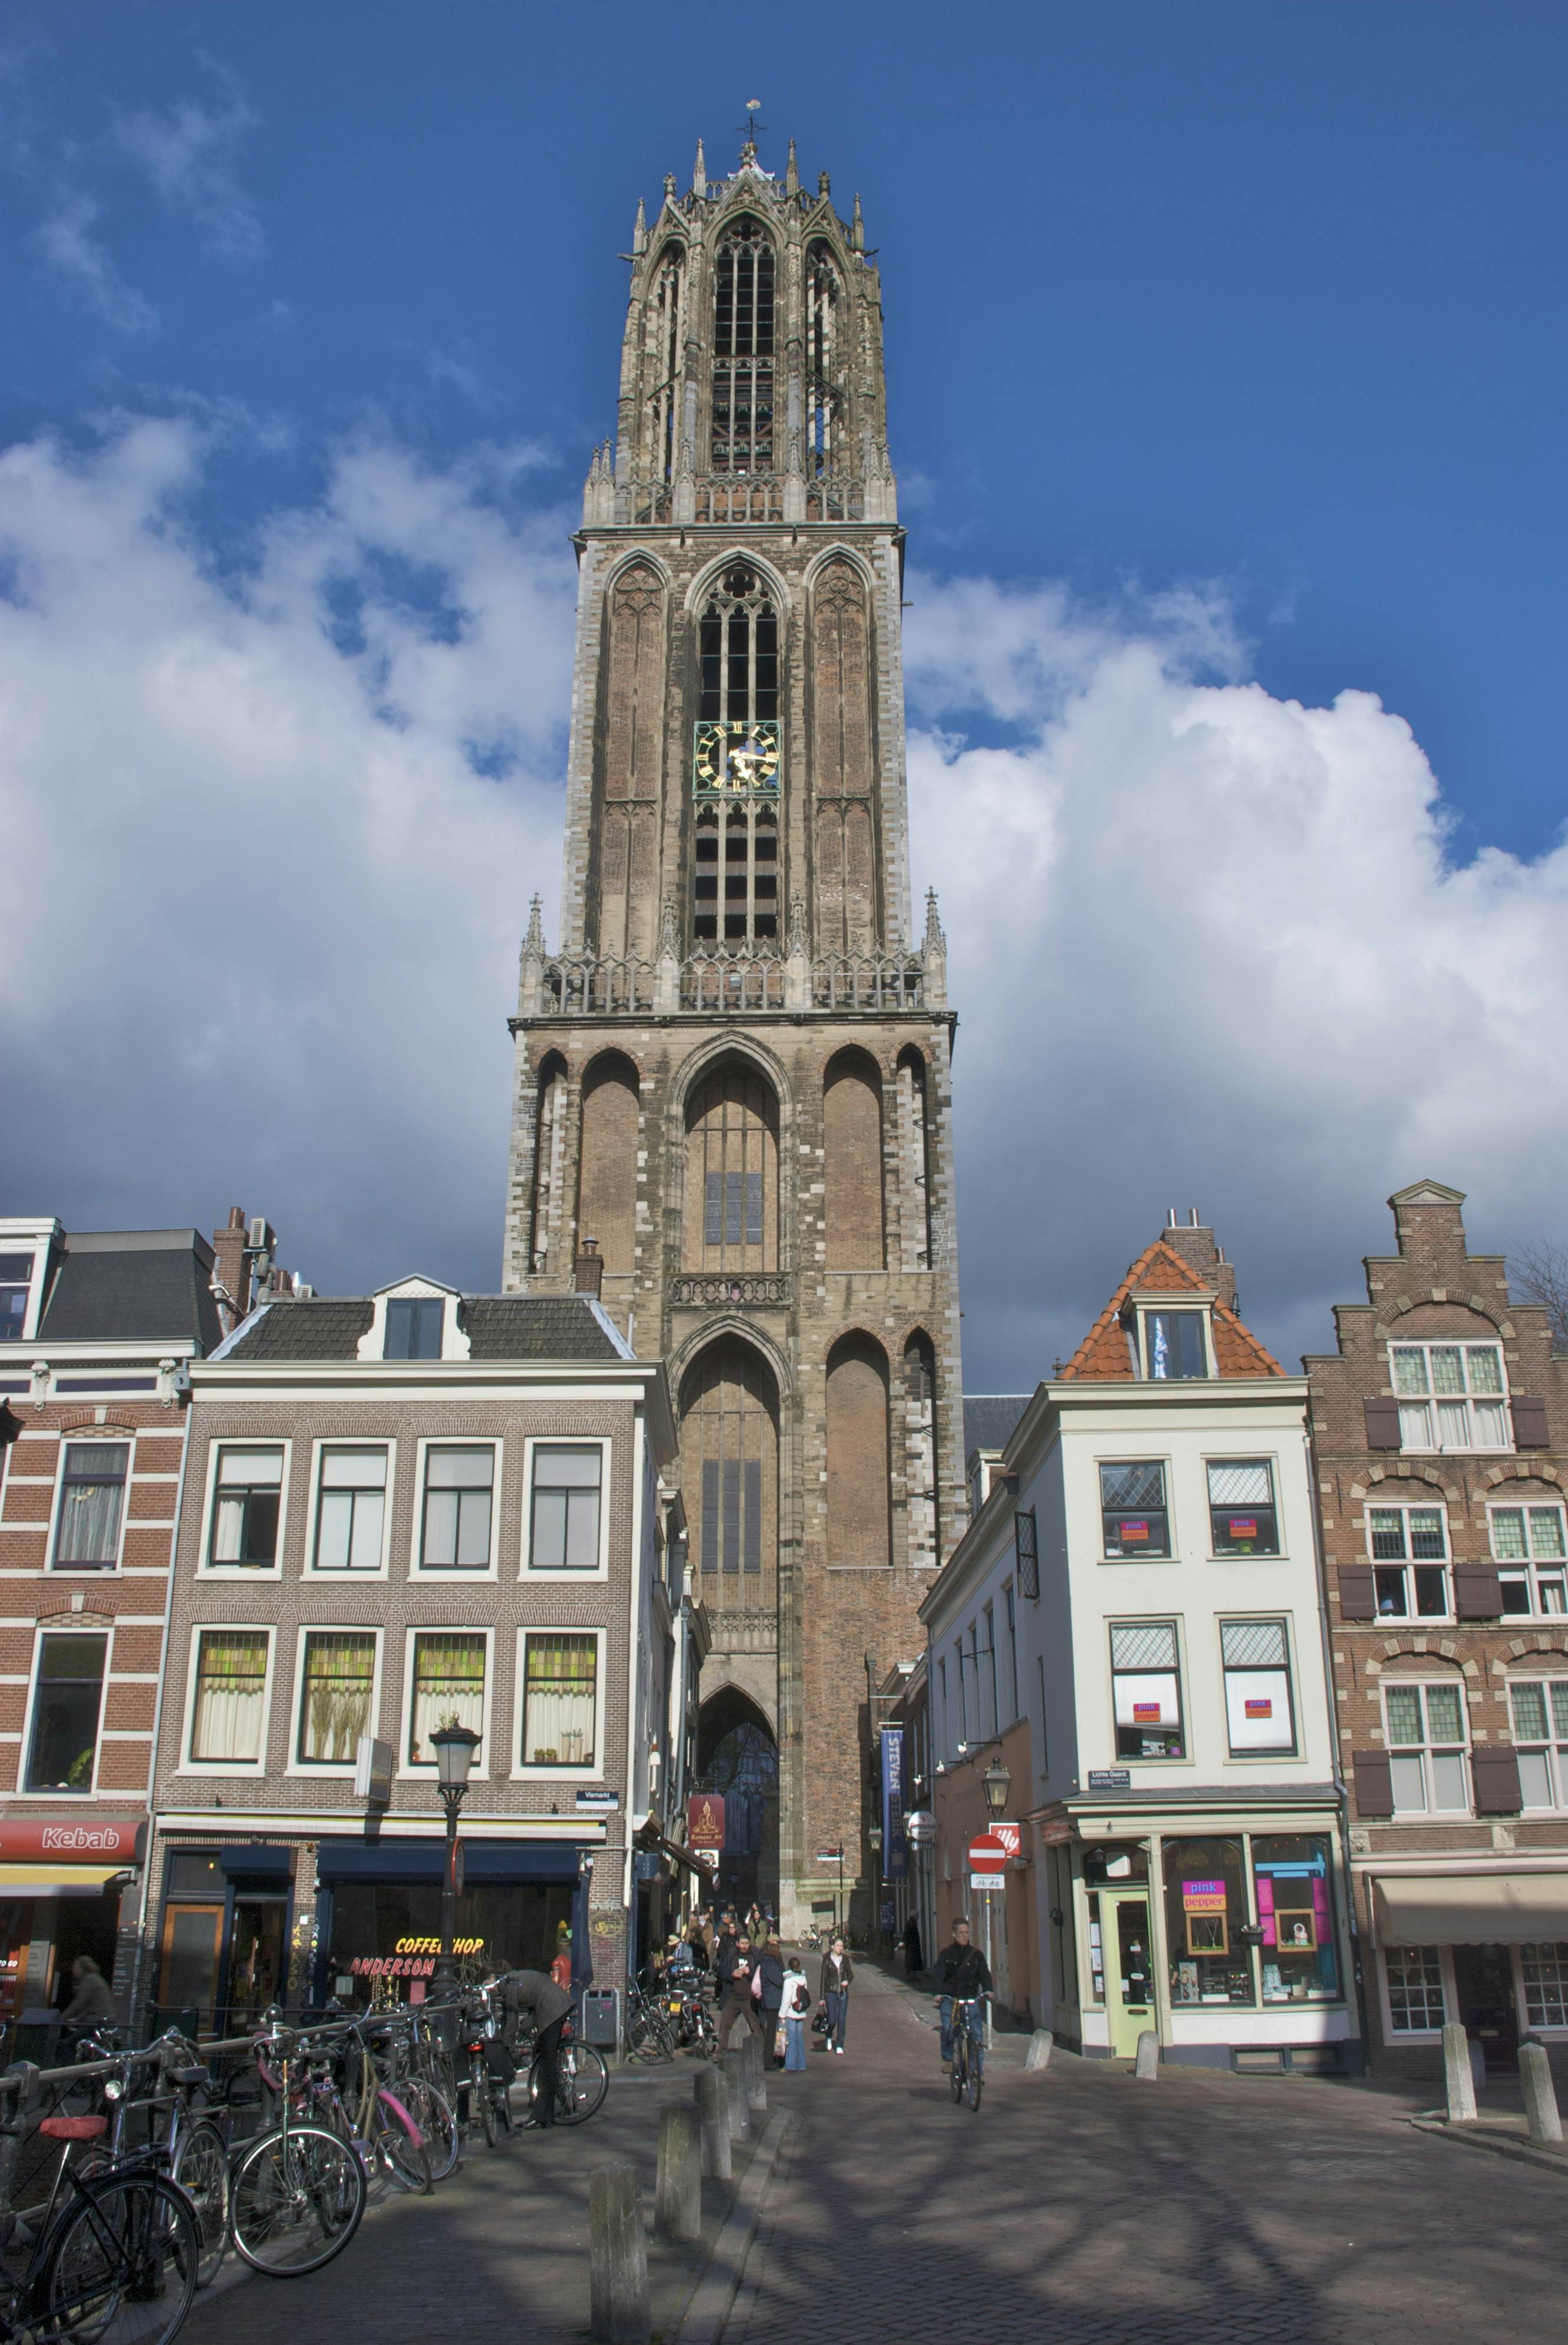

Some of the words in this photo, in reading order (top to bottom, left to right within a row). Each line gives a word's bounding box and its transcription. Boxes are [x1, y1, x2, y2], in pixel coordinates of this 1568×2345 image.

[888, 1737, 901, 1789] STEVEN
[890, 1794, 902, 1838] STERK
[42, 1828, 119, 1849] Kebab
[997, 1829, 1020, 1853] illy
[1191, 1882, 1216, 1894] pink
[1185, 1898, 1224, 1908] pepper
[349, 1957, 435, 1975] ANDERSOM
